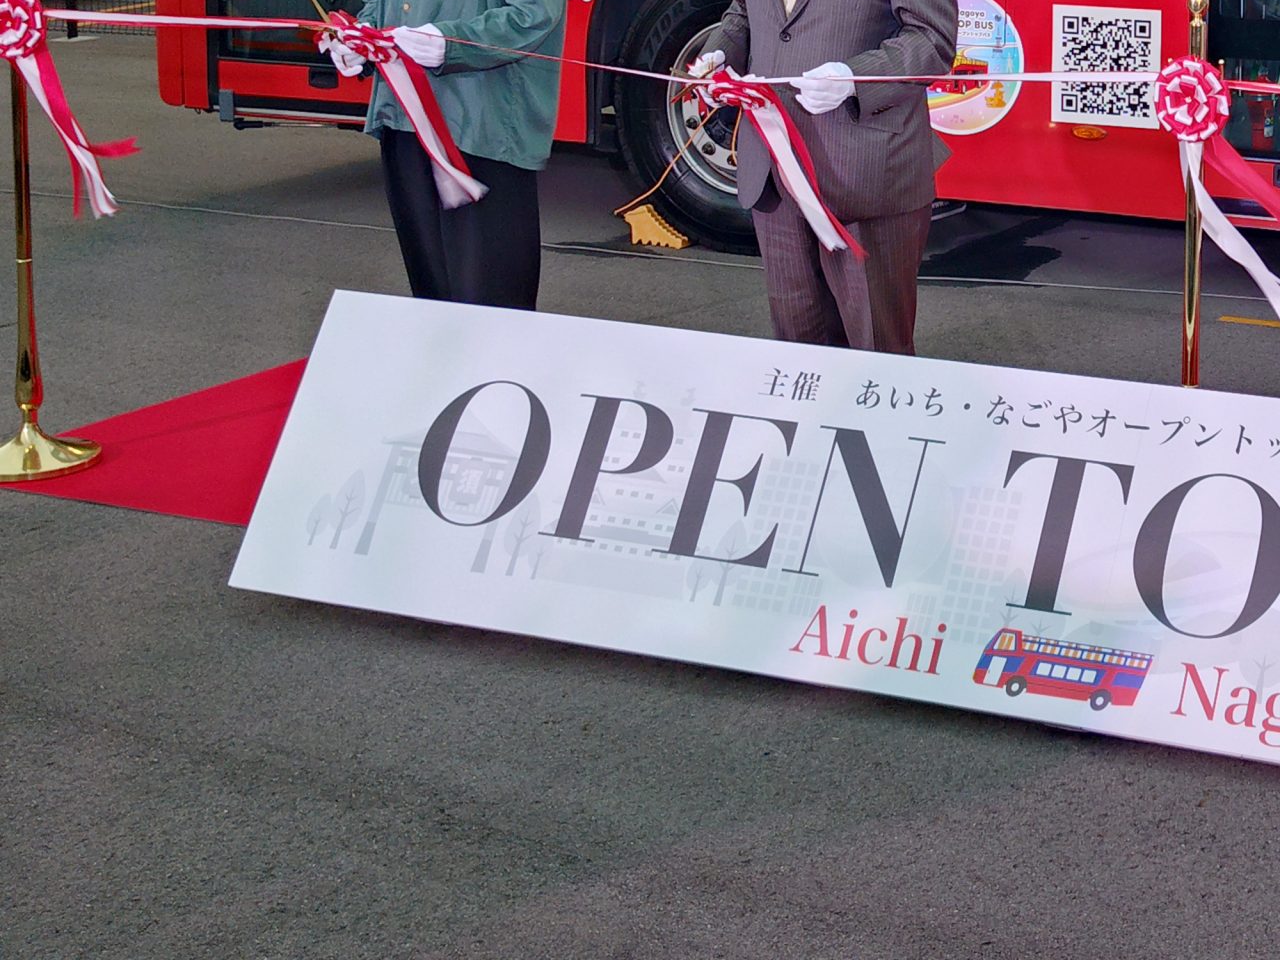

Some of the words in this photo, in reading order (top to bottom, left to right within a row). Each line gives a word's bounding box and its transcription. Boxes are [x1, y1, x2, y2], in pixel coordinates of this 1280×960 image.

[960, 10, 985, 18] agoya
[974, 21, 994, 30] BUS
[757, 368, 823, 403] 主催
[416, 380, 947, 589] OPEN
[788, 603, 947, 677] Aichi
